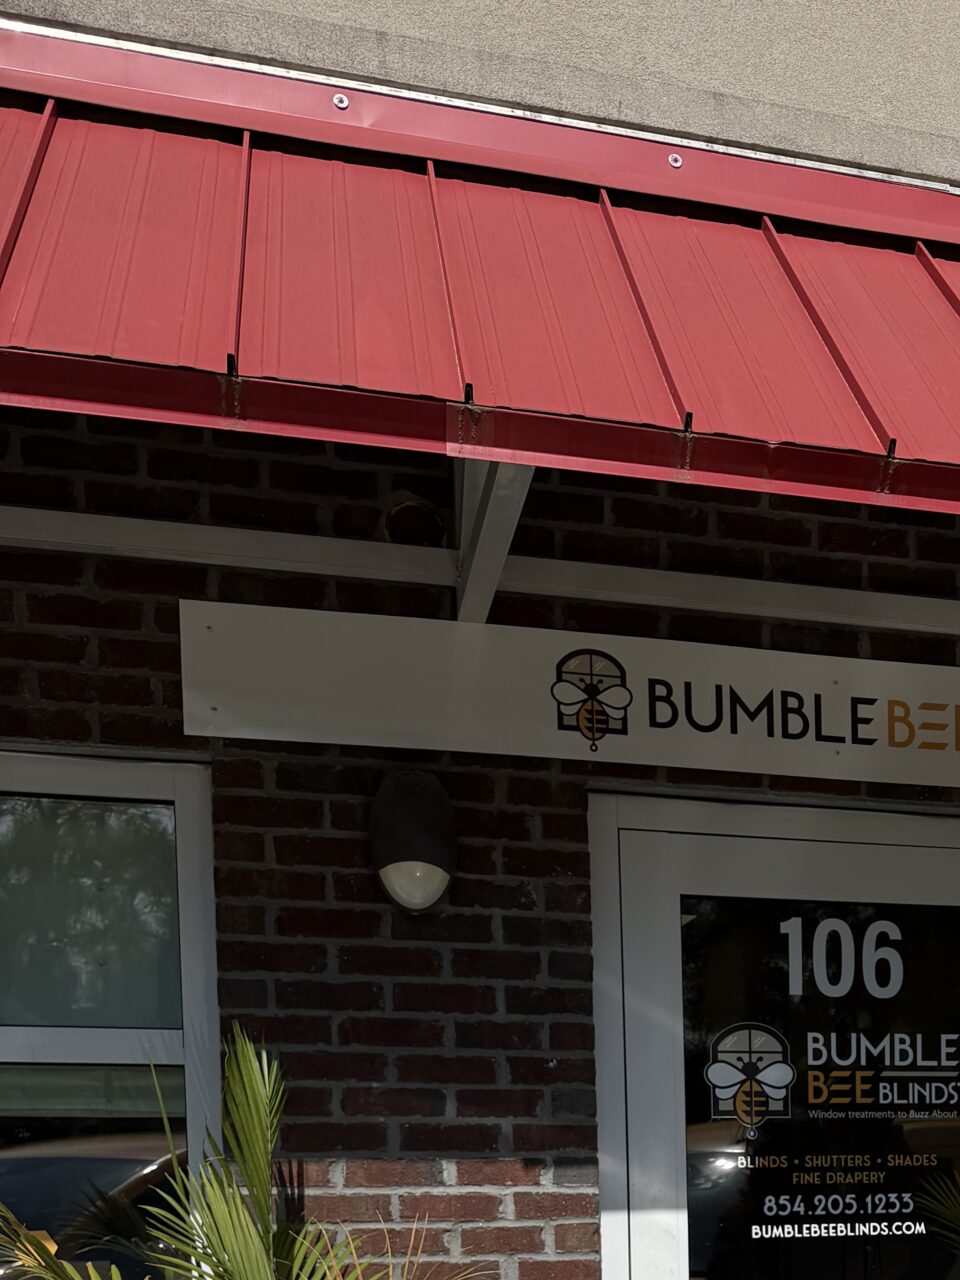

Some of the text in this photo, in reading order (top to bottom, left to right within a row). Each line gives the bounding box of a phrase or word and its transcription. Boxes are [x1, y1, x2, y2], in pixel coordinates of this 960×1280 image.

[780, 916, 904, 999] 106
[807, 1032, 960, 1067] BUMBLE
[808, 1070, 959, 1105] BEE BLINDS
[808, 1109, 958, 1119] Window treatments to Buzz About
[737, 1154, 938, 1168] BLINDS SHUTTERS SHADES
[793, 1171, 886, 1185] FINE DRAPERY
[764, 1193, 914, 1216] 854.205.1233
[751, 1221, 926, 1239] BUMBLEBEEBLINDS.COM
